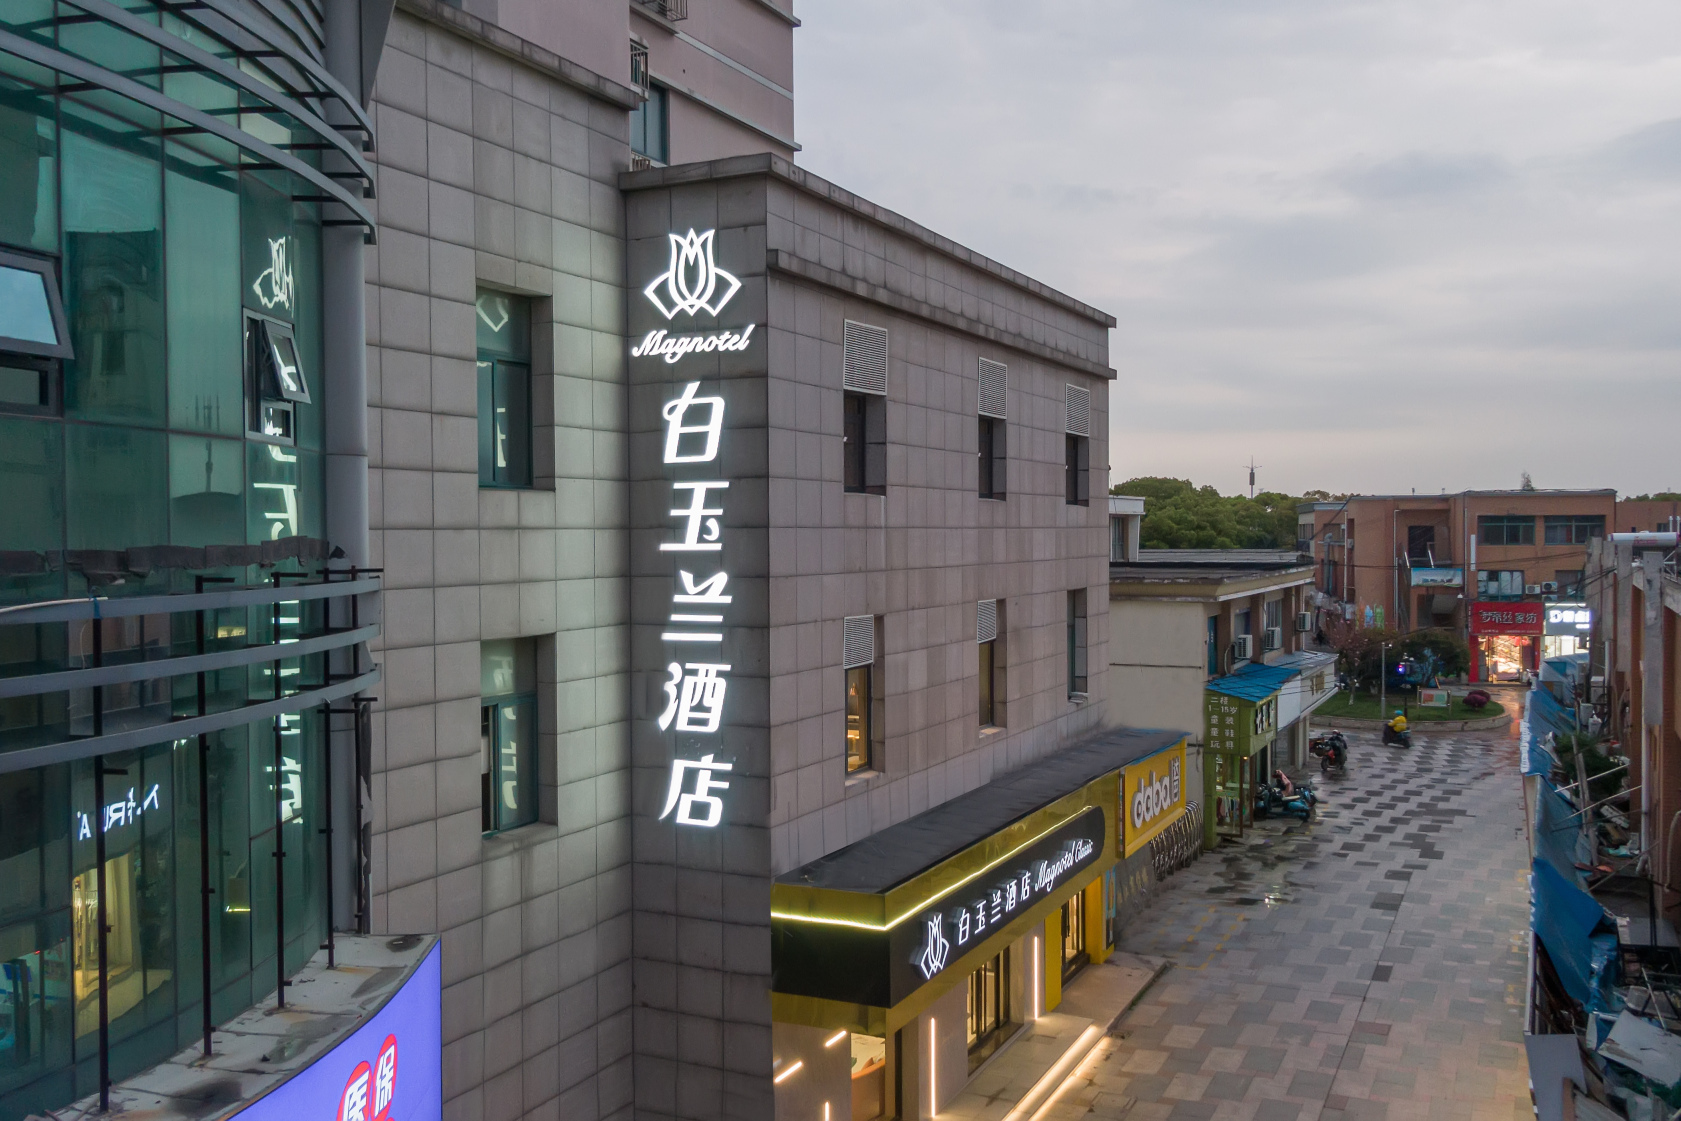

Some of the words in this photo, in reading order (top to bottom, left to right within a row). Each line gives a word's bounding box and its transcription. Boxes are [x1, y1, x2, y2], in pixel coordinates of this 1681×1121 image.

[632, 324, 755, 364] Magnotel
[659, 381, 732, 827] 白玉兰酒店
[1210, 697, 1229, 705] 二楼
[1133, 771, 1171, 829] daba
[958, 870, 1032, 946] 白玉兰酒店
[1035, 841, 1076, 893] Magnotel
